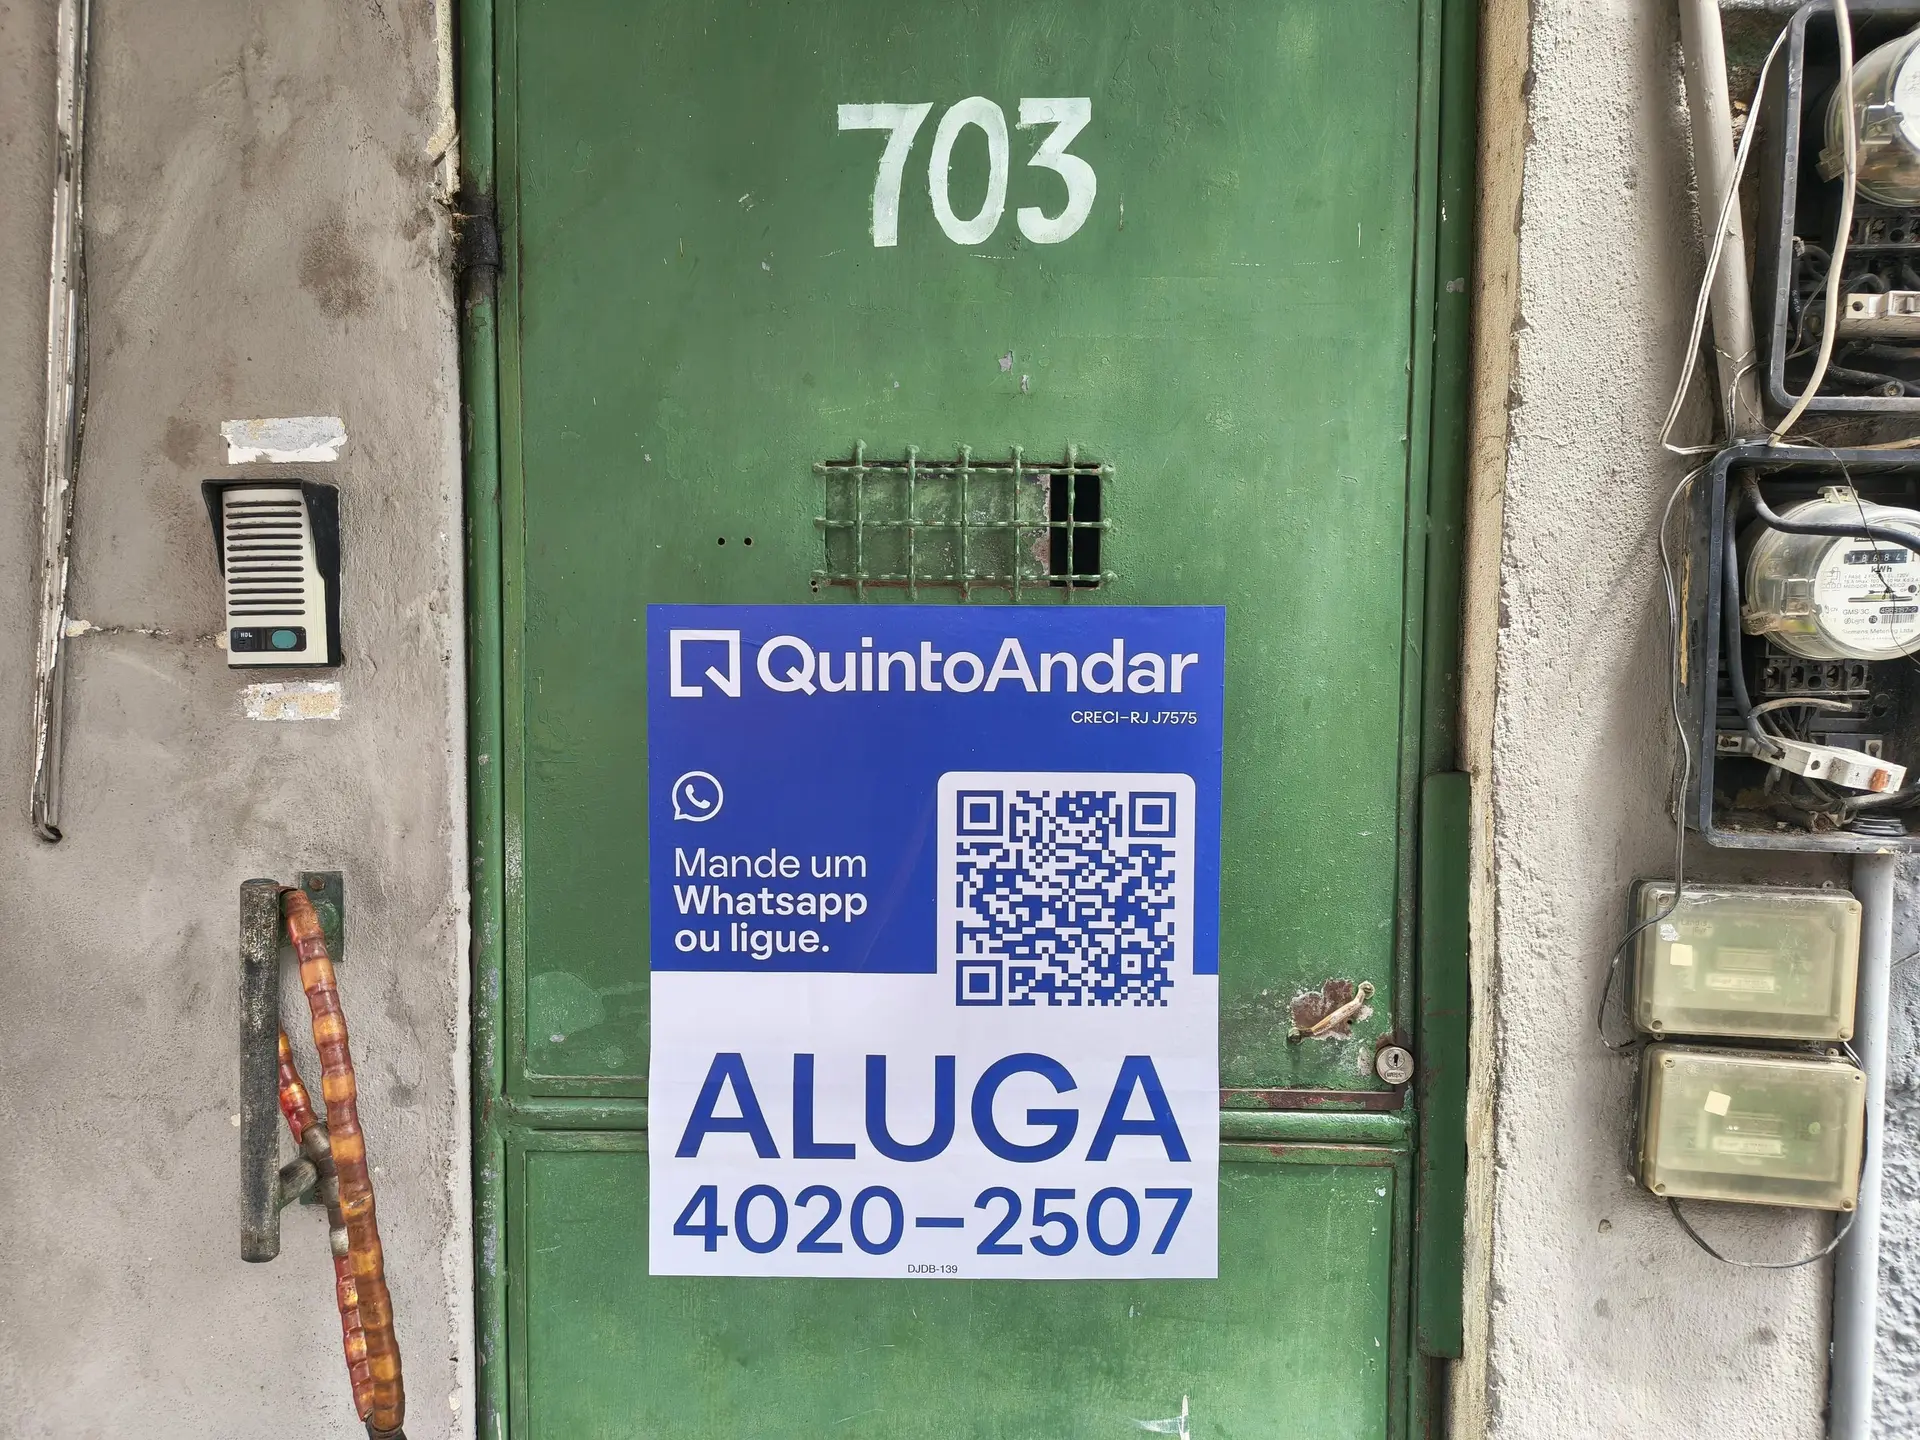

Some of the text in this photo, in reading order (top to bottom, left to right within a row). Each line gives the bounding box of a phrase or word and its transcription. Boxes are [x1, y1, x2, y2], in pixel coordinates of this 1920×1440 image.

[837, 95, 1097, 248] 703
[1871, 565, 1893, 573] kWh
[756, 635, 1199, 696] QuintoAndar
[1070, 710, 1198, 725] CRECI-RJ J7575
[674, 847, 867, 879] Mande um
[673, 884, 868, 923] Whatsapp
[674, 922, 831, 961] ou ligue.
[674, 1052, 1192, 1163] ALUGA
[673, 1183, 1193, 1257] 4020-2507
[907, 1264, 958, 1274] DJDB-139
